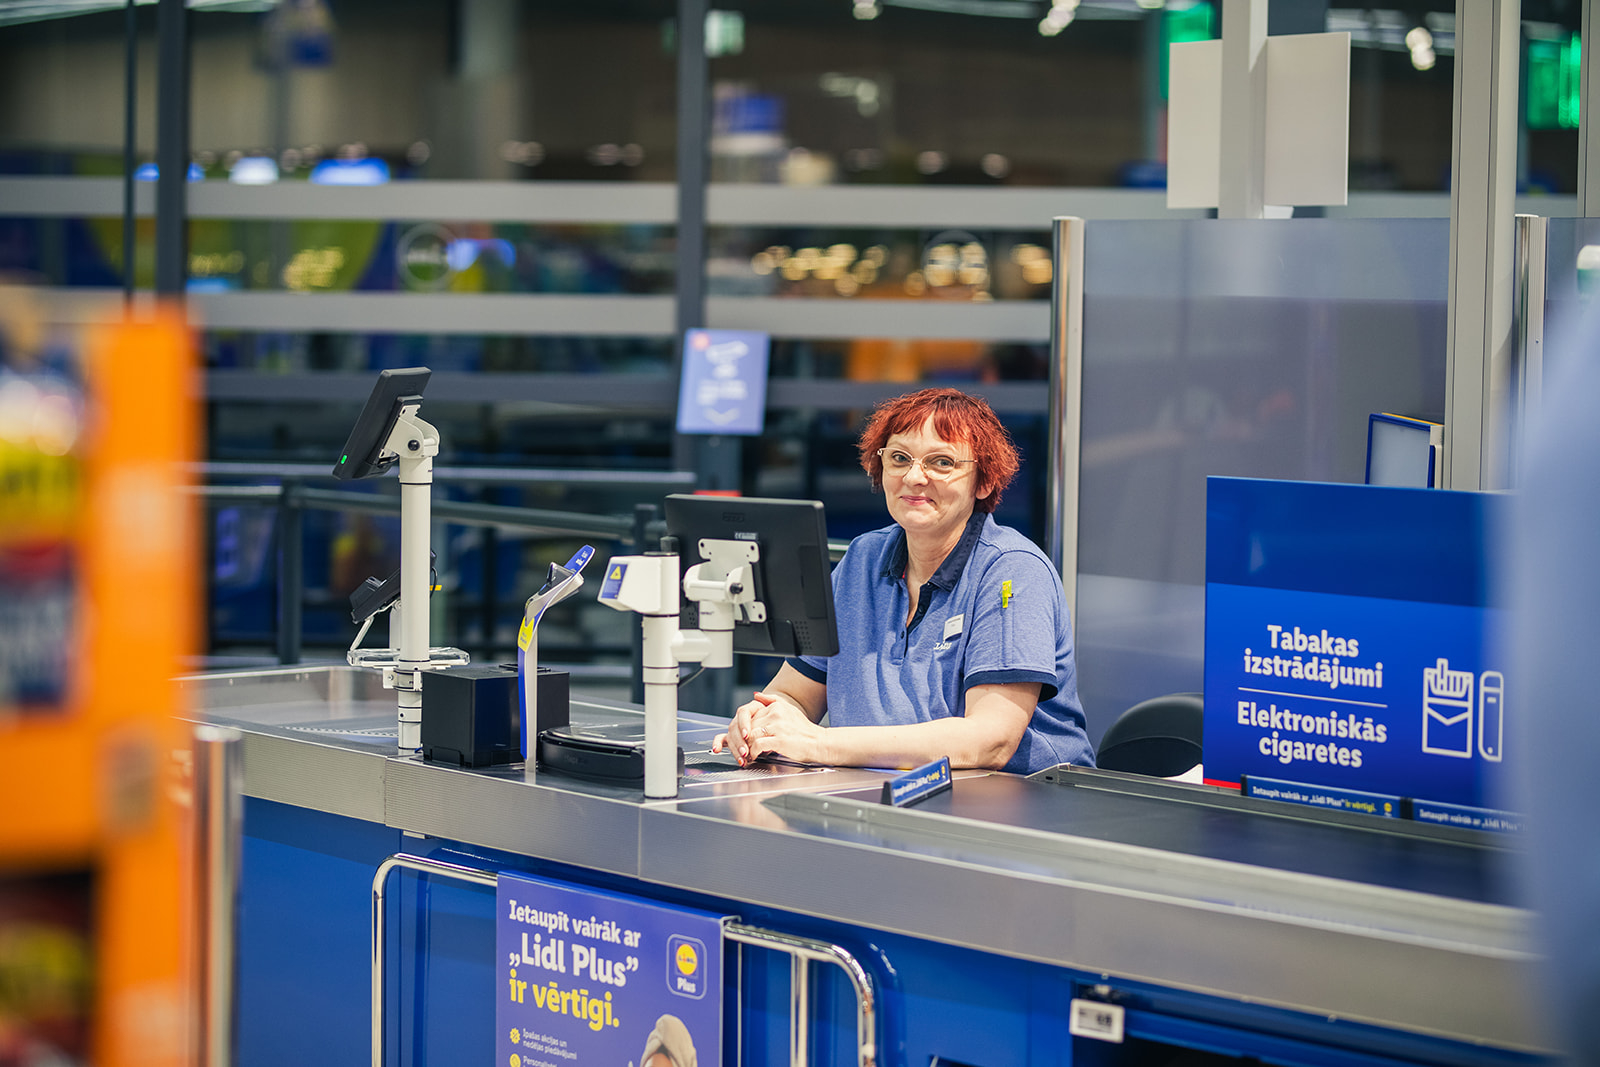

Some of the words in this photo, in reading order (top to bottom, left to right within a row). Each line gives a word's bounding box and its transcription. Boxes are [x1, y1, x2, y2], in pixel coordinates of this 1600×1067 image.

[1267, 624, 1359, 658] Tabakas
[1244, 647, 1383, 689] izstrādājumi
[1237, 701, 1388, 743] Elektroniskās
[1258, 731, 1363, 768] cigaretes
[509, 899, 570, 934] Ietaupīt
[572, 915, 621, 945] vairāk
[623, 929, 641, 948] ar
[509, 932, 566, 974] „Lidl
[509, 968, 528, 1004] ir
[532, 981, 620, 1032] vērtīgi.
[677, 977, 696, 993] Plus
